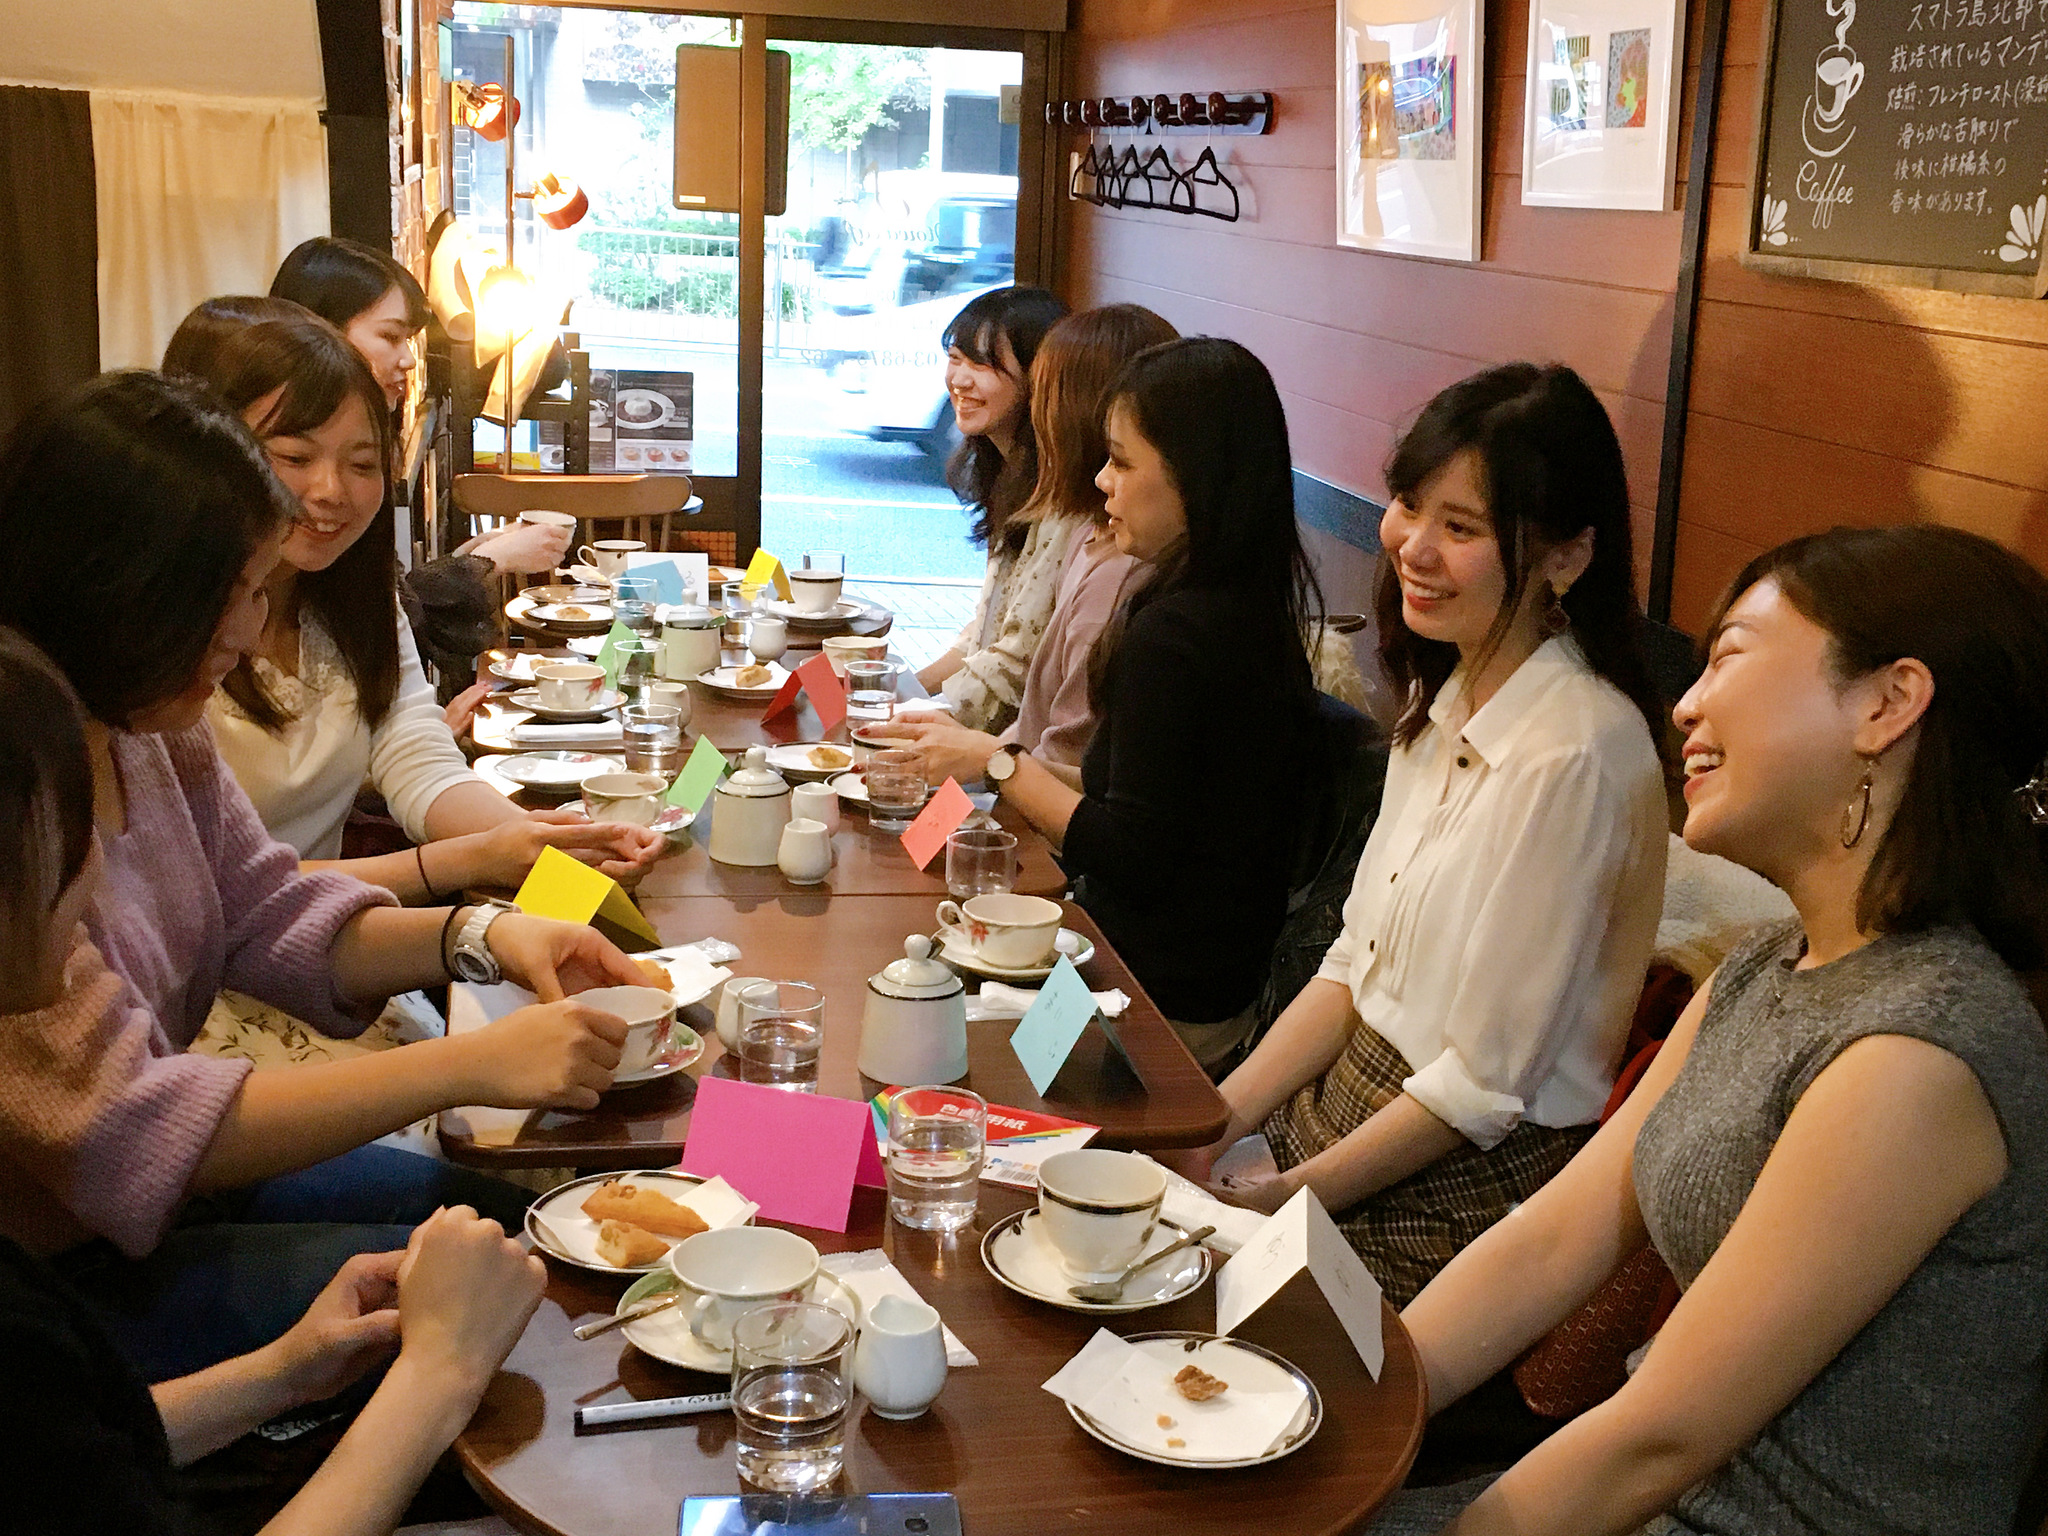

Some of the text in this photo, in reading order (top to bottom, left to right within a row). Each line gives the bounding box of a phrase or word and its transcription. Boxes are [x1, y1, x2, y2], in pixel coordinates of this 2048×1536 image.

[1889, 29, 2048, 73] 栽培されているマンデ
[1796, 160, 1854, 230] Coffee
